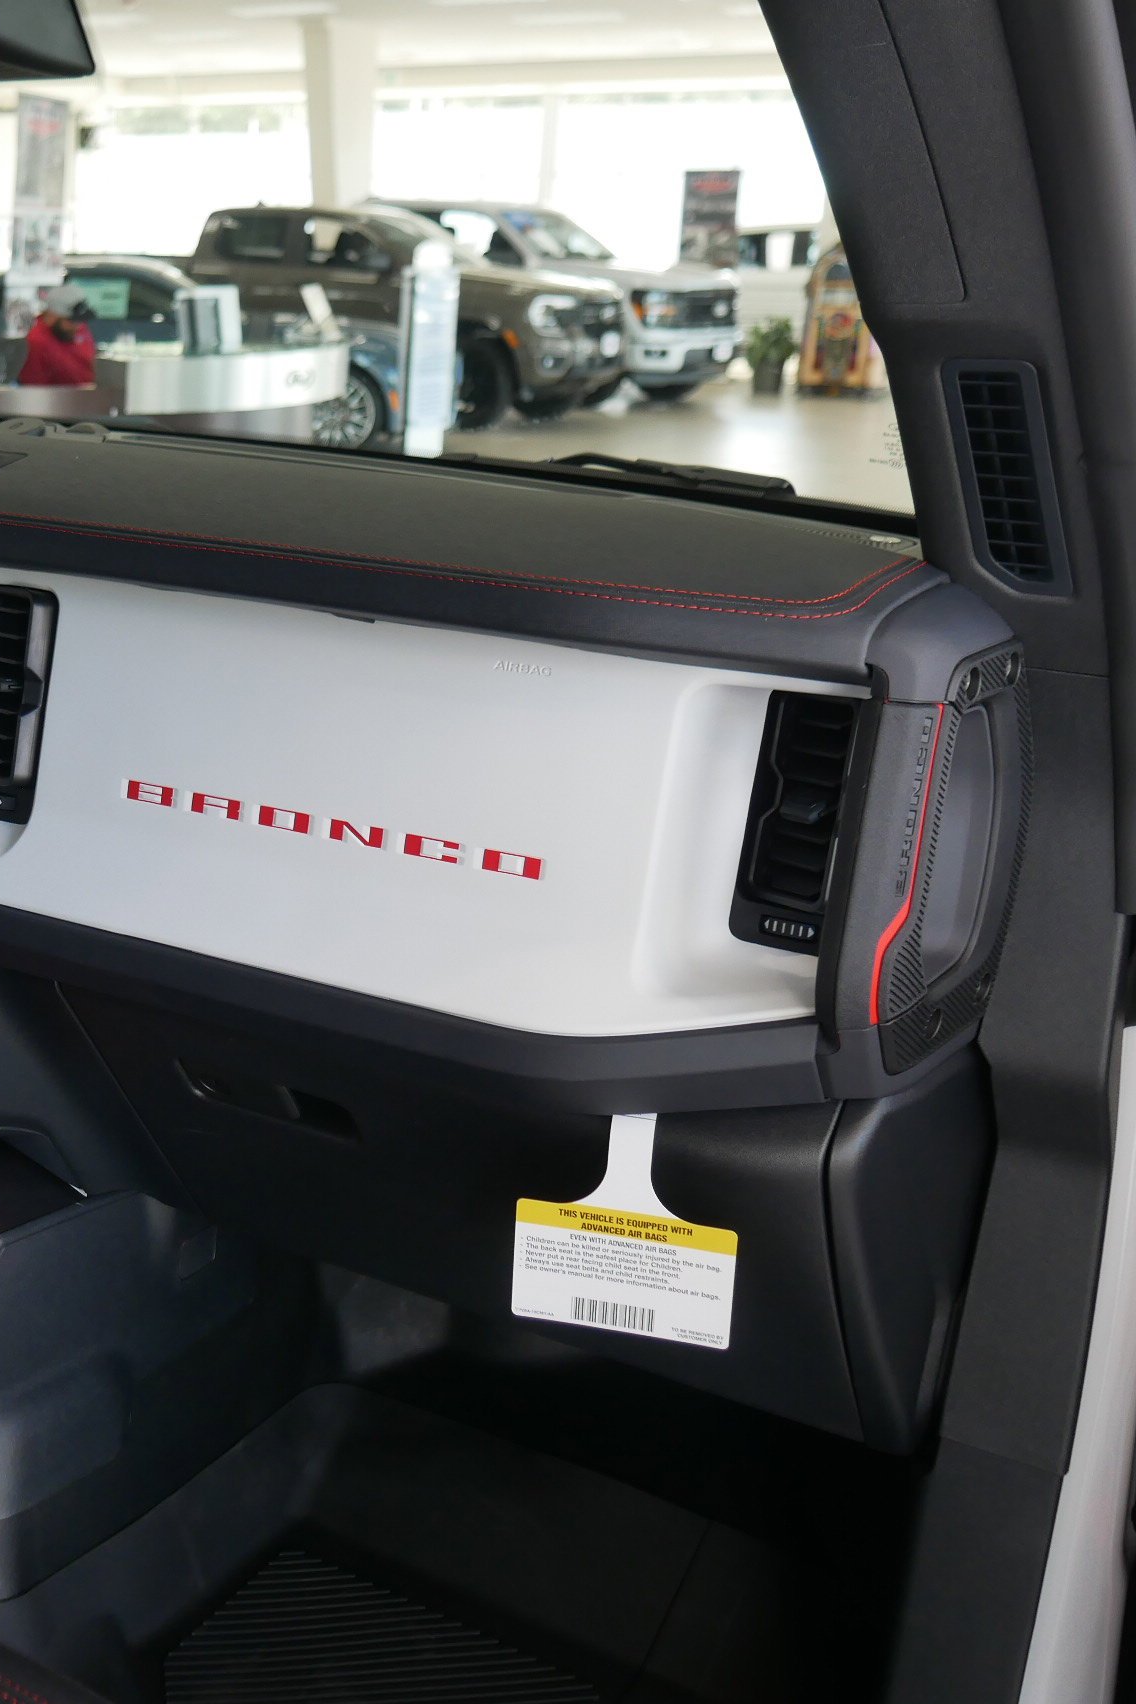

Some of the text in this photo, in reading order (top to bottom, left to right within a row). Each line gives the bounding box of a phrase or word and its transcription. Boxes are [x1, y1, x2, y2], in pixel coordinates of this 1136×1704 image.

[492, 660, 552, 677] AIRBAG
[895, 716, 933, 897] BRONCO
[123, 779, 545, 881] BRONCO
[559, 1208, 693, 1236] THIS VEHICLE IS EQUIPPED WITH
[581, 1222, 667, 1242] ADVANCED AIR BAGS
[526, 1236, 555, 1245] Children
[582, 1243, 600, 1252] killed
[611, 1249, 643, 1259] seriously
[645, 1253, 670, 1263] injured
[671, 1258, 680, 1267] by
[540, 1244, 556, 1252] back
[596, 1253, 617, 1262] safest
[619, 1256, 637, 1265] place
[650, 1262, 683, 1273] Children.
[570, 1234, 677, 1256] EVEN WITH ADVANCED AIR BAGS
[525, 1249, 545, 1258] Never
[581, 1258, 603, 1267] facing
[604, 1262, 622, 1270] child
[648, 1268, 660, 1276] the
[525, 1256, 549, 1266] Always
[582, 1265, 599, 1273] belts
[615, 1270, 633, 1278] child
[539, 1266, 565, 1275] owner's
[567, 1270, 593, 1279] manual
[606, 1276, 624, 1284] more
[625, 1279, 666, 1291] information
[668, 1286, 689, 1295] about
[677, 1333, 707, 1343] CUSTOMER
[688, 1330, 715, 1339] REMOVED
